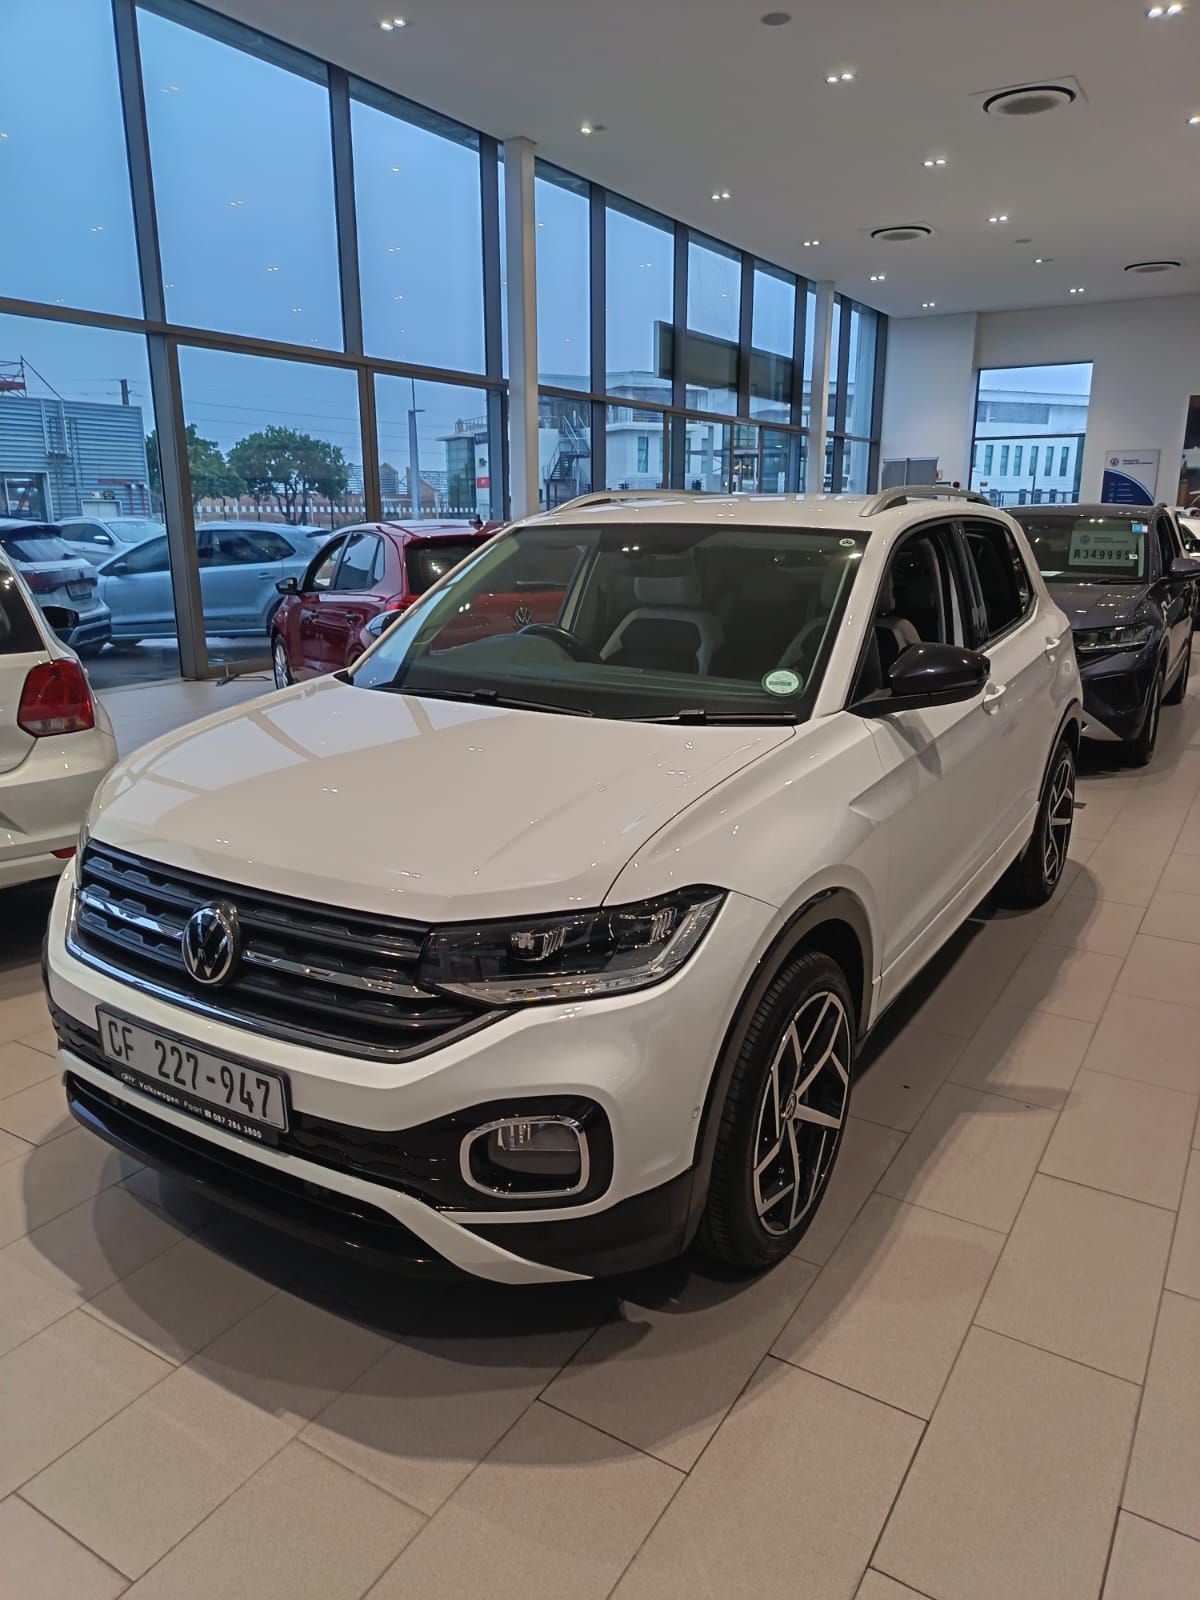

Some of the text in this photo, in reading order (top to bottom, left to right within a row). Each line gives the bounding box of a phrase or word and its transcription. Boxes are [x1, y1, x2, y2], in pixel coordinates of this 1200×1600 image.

[108, 1020, 270, 1118] CF 227-947
[138, 1081, 179, 1105] Volkswagen
